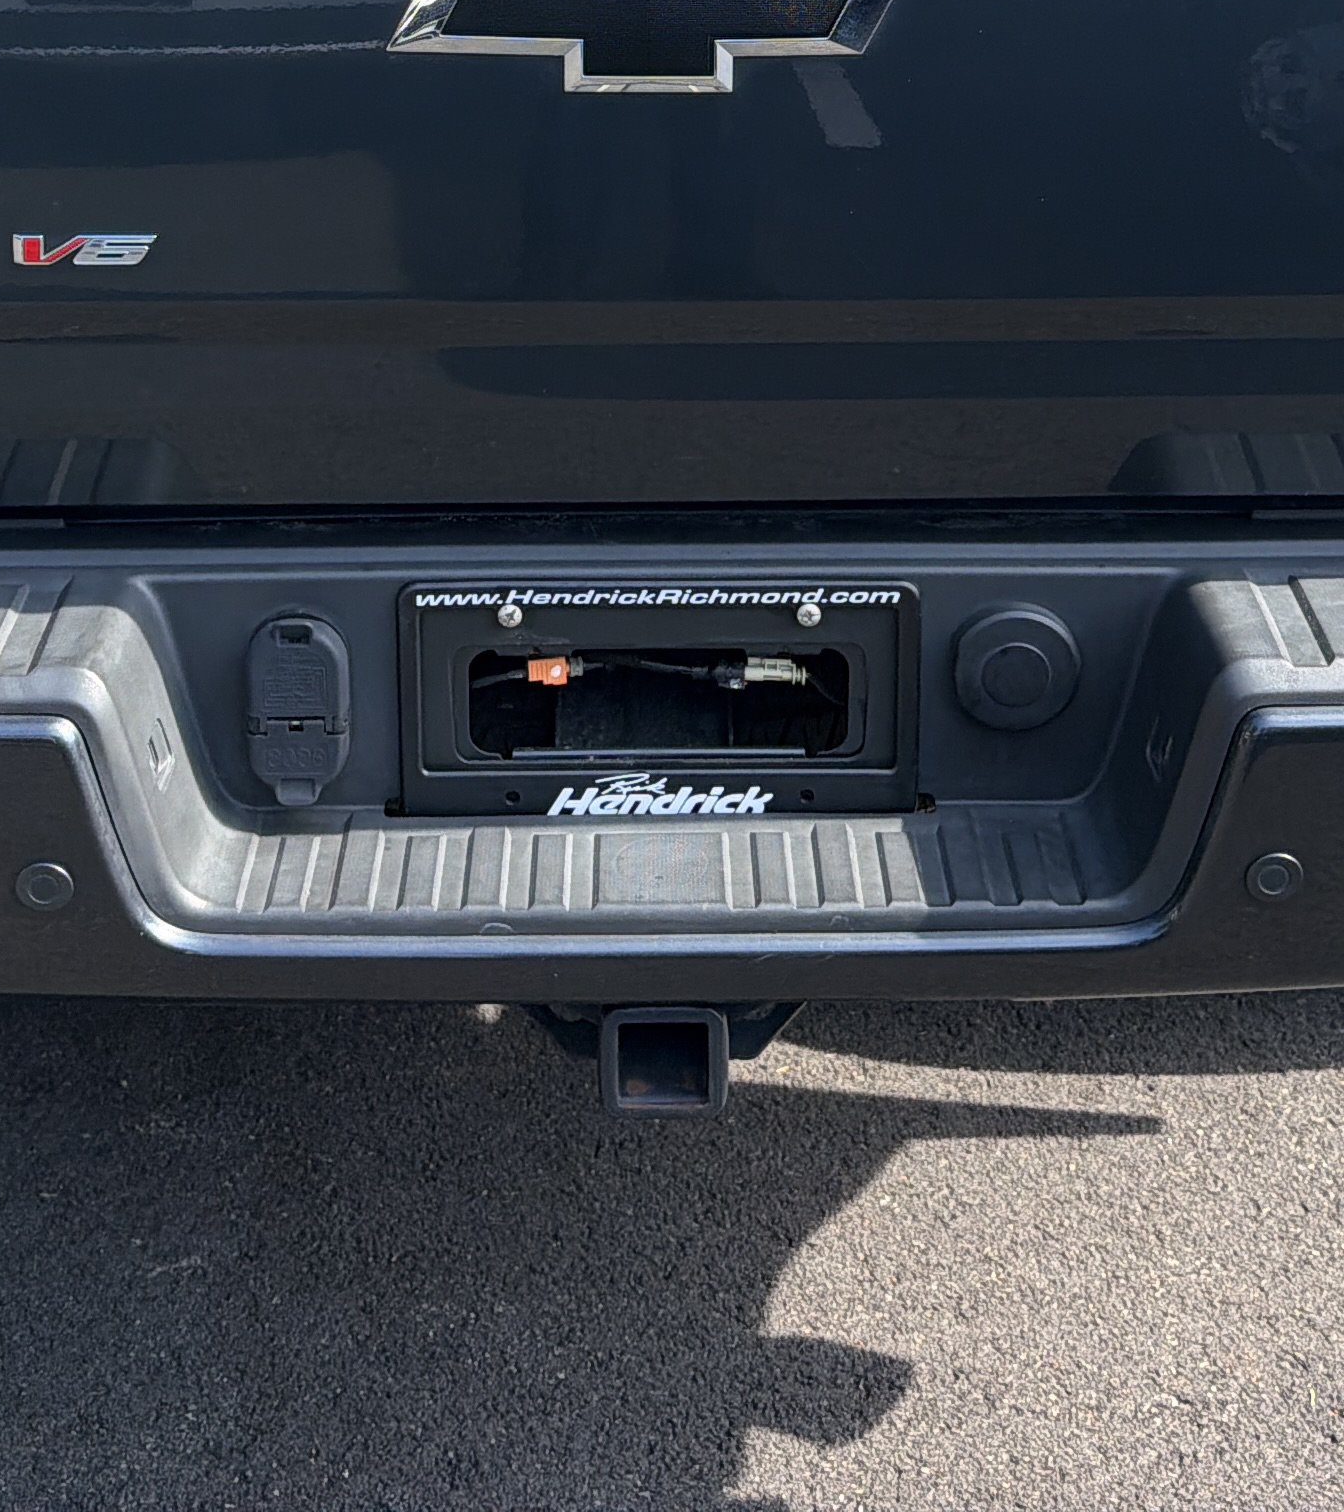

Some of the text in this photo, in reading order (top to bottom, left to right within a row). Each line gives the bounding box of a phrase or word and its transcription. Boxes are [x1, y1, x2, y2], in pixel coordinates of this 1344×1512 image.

[12, 233, 158, 266] V6
[415, 588, 901, 607] www.HendrickRichmond.com
[546, 786, 774, 816] Hendrick
